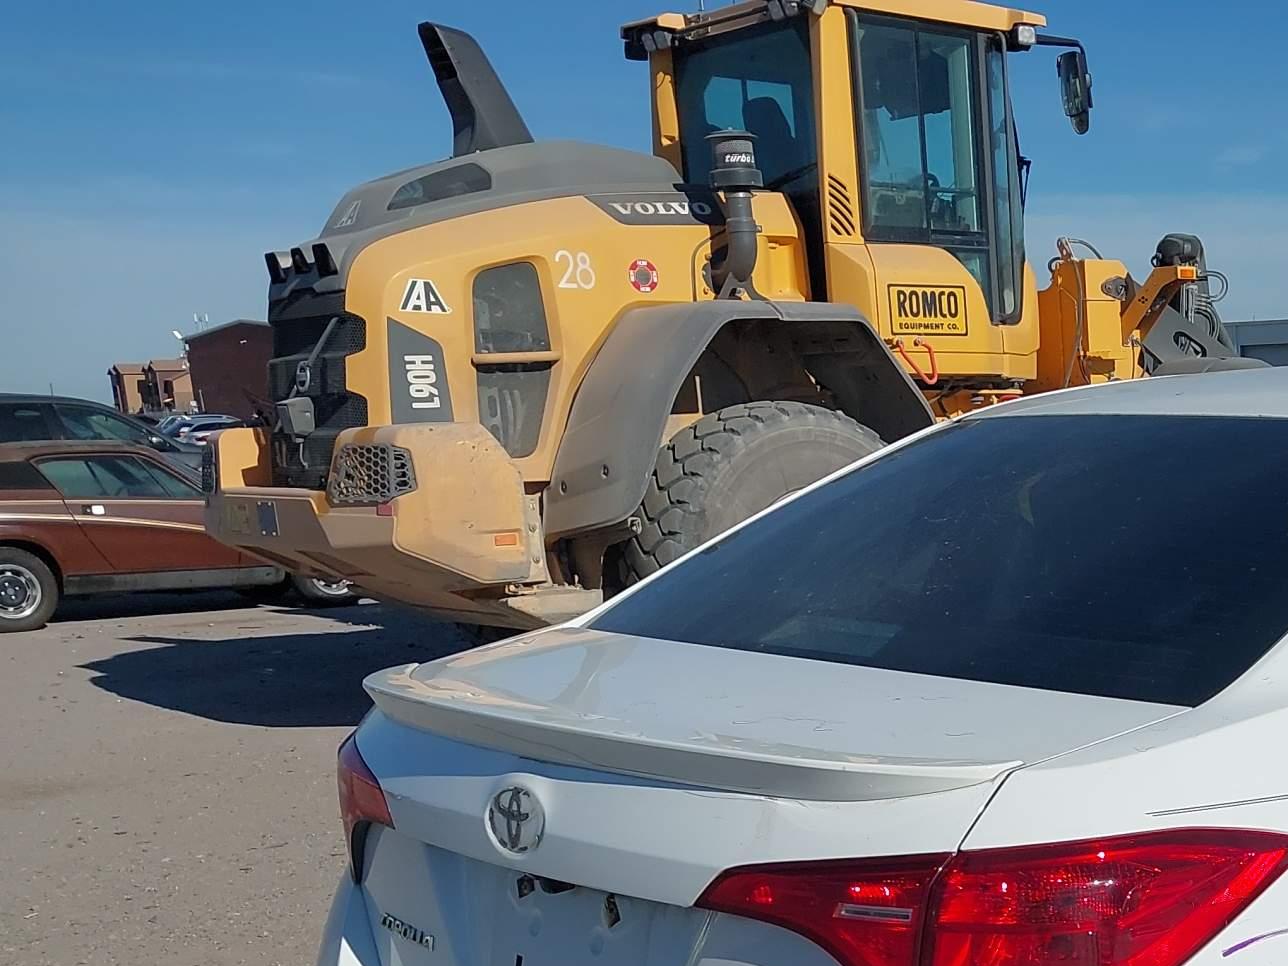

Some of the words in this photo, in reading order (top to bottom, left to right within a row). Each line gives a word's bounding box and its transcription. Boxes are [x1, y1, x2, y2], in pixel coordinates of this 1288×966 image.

[608, 201, 713, 216] VOLVO
[555, 250, 596, 290] 28
[401, 280, 448, 312] IAA
[896, 289, 959, 318] ROMCO
[899, 322, 945, 331] EQUIPMENT
[946, 322, 960, 331] CO.
[403, 354, 441, 409] L90H
